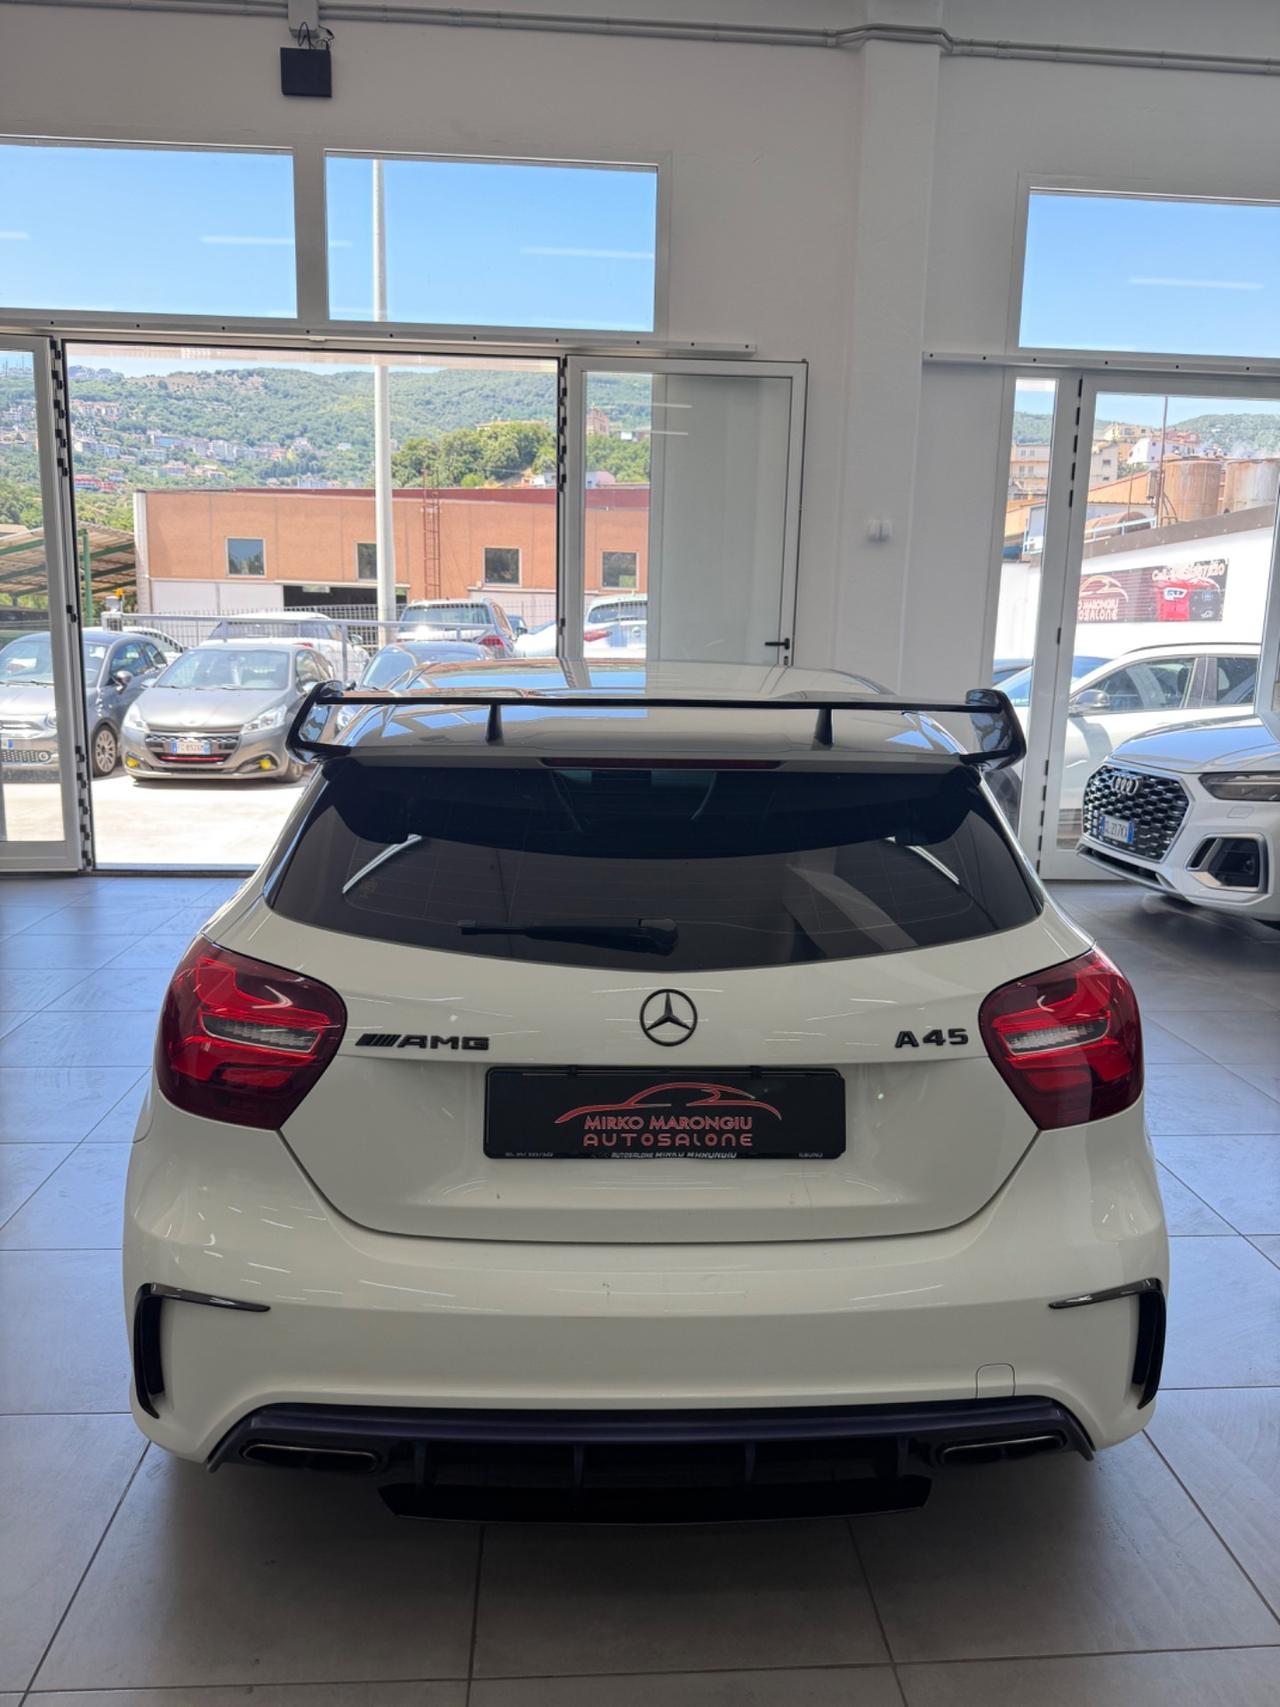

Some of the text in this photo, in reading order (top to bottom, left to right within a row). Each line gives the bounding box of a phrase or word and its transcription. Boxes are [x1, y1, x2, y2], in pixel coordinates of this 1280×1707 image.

[397, 1034, 490, 1050] AMG
[584, 1115, 753, 1130] MIRKO MARONGIU
[583, 1133, 753, 1147] AUTOSALONE
